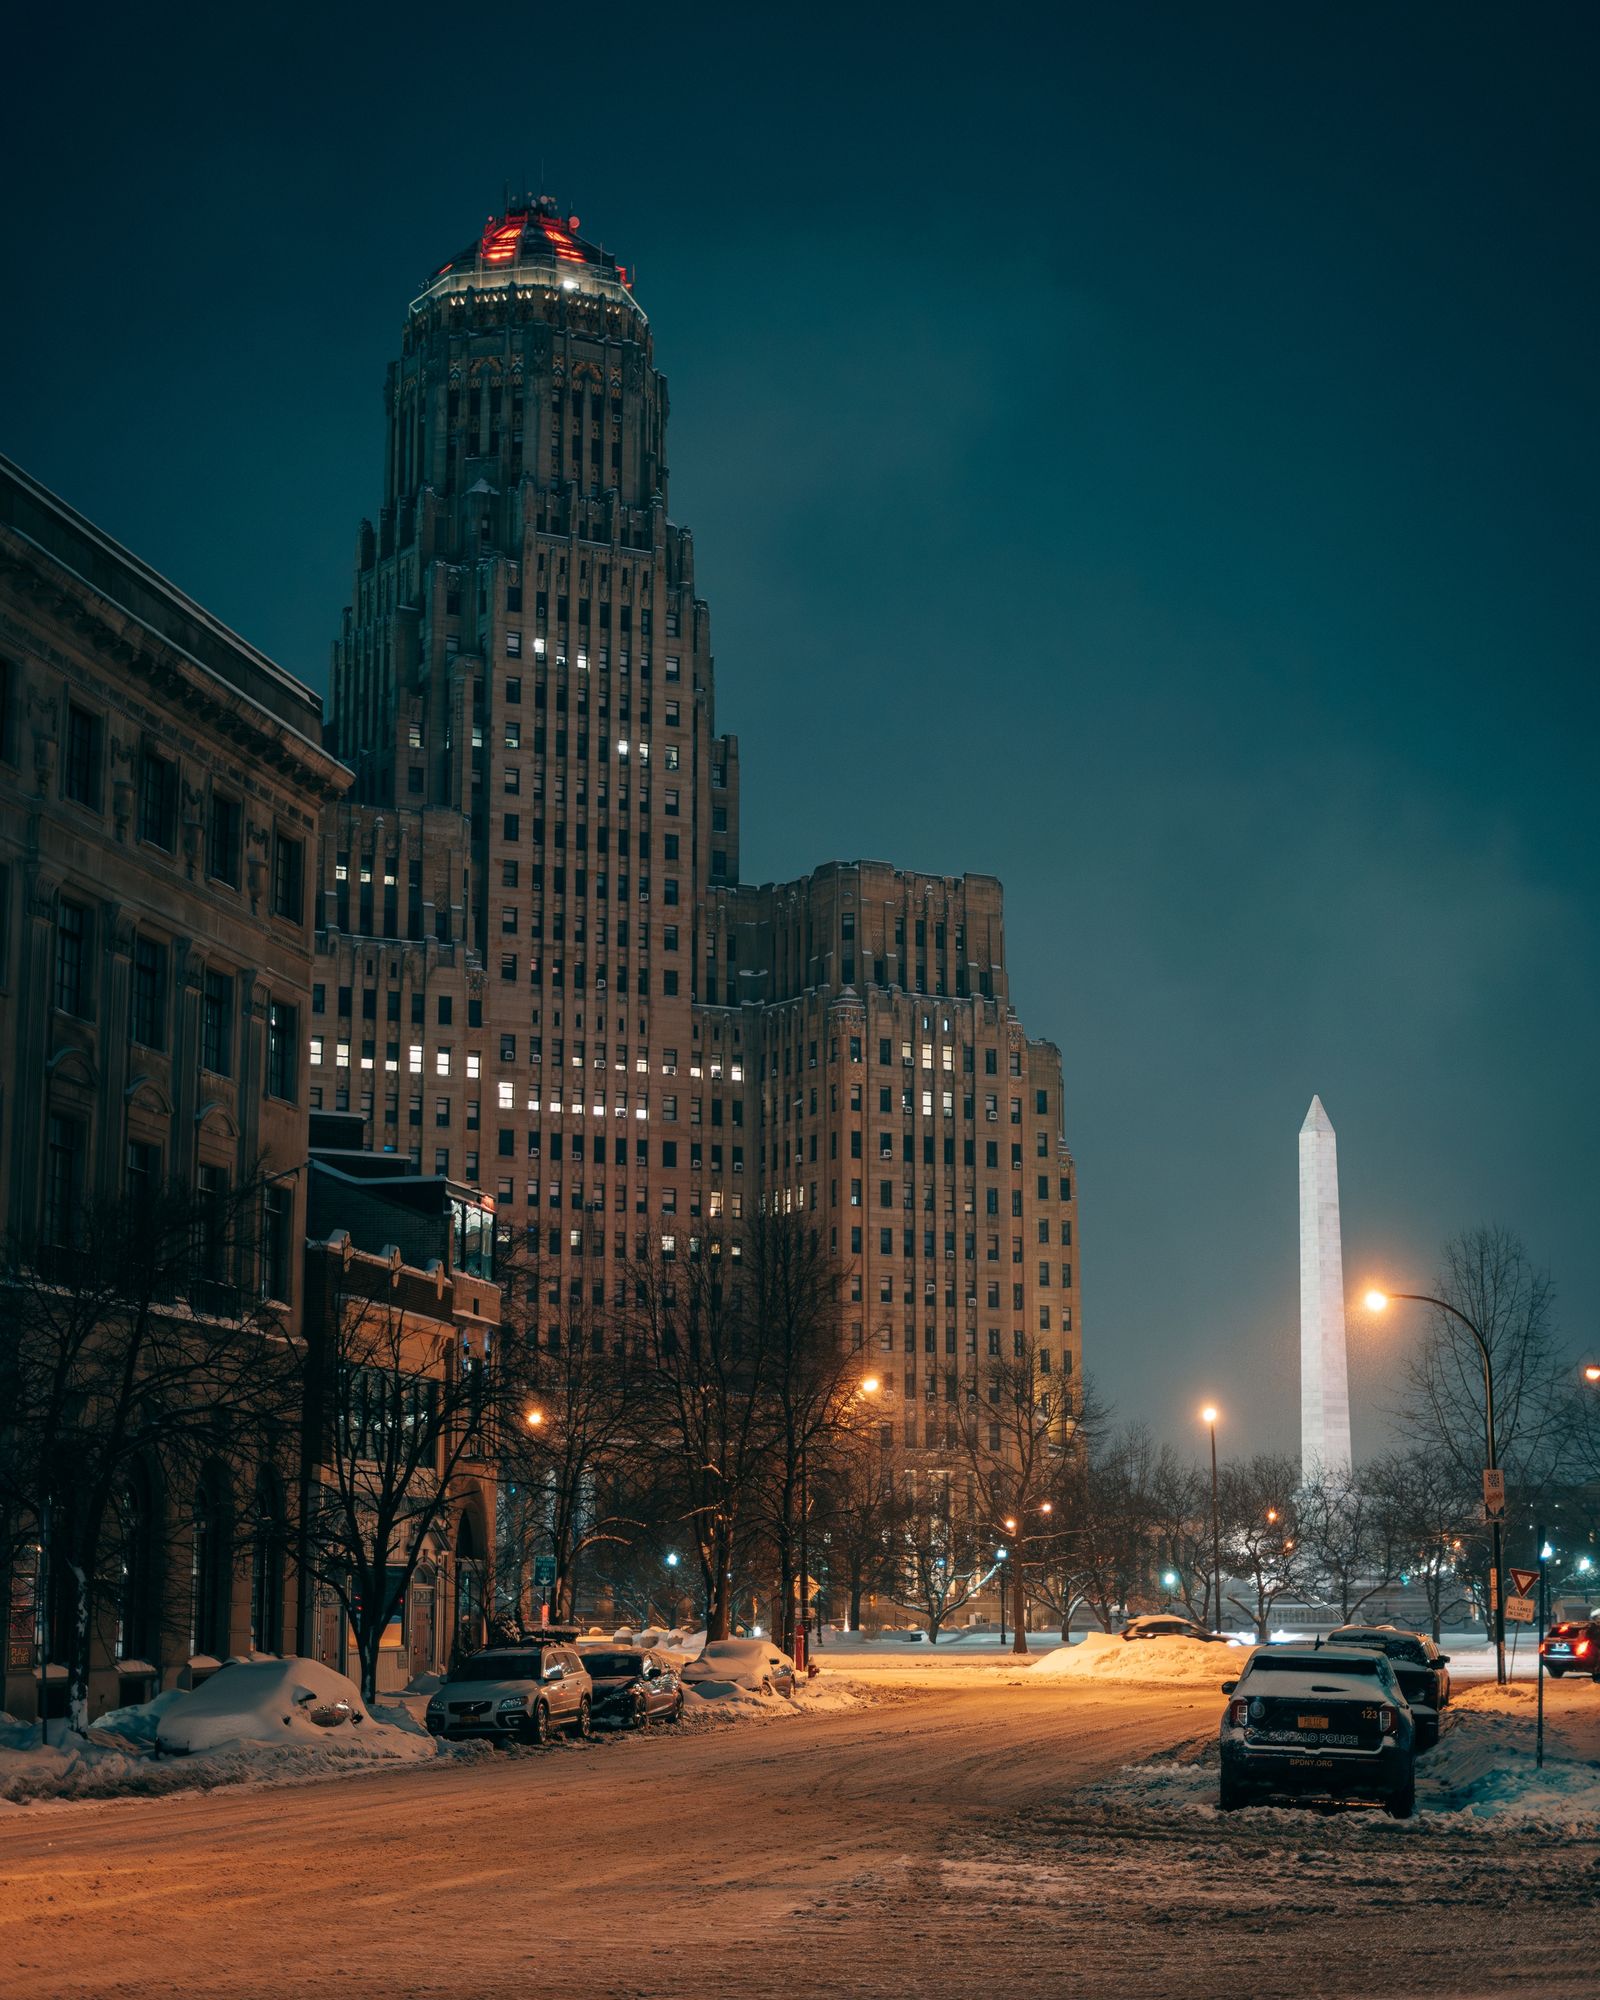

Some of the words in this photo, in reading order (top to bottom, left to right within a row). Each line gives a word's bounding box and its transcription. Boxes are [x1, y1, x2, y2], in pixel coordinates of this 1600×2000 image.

[11, 1647, 29, 1656] PLAZA
[1361, 1711, 1378, 1719] 123
[1319, 1733, 1359, 1745] POLICE
[1290, 1759, 1333, 1767] BPDNY.ORG
